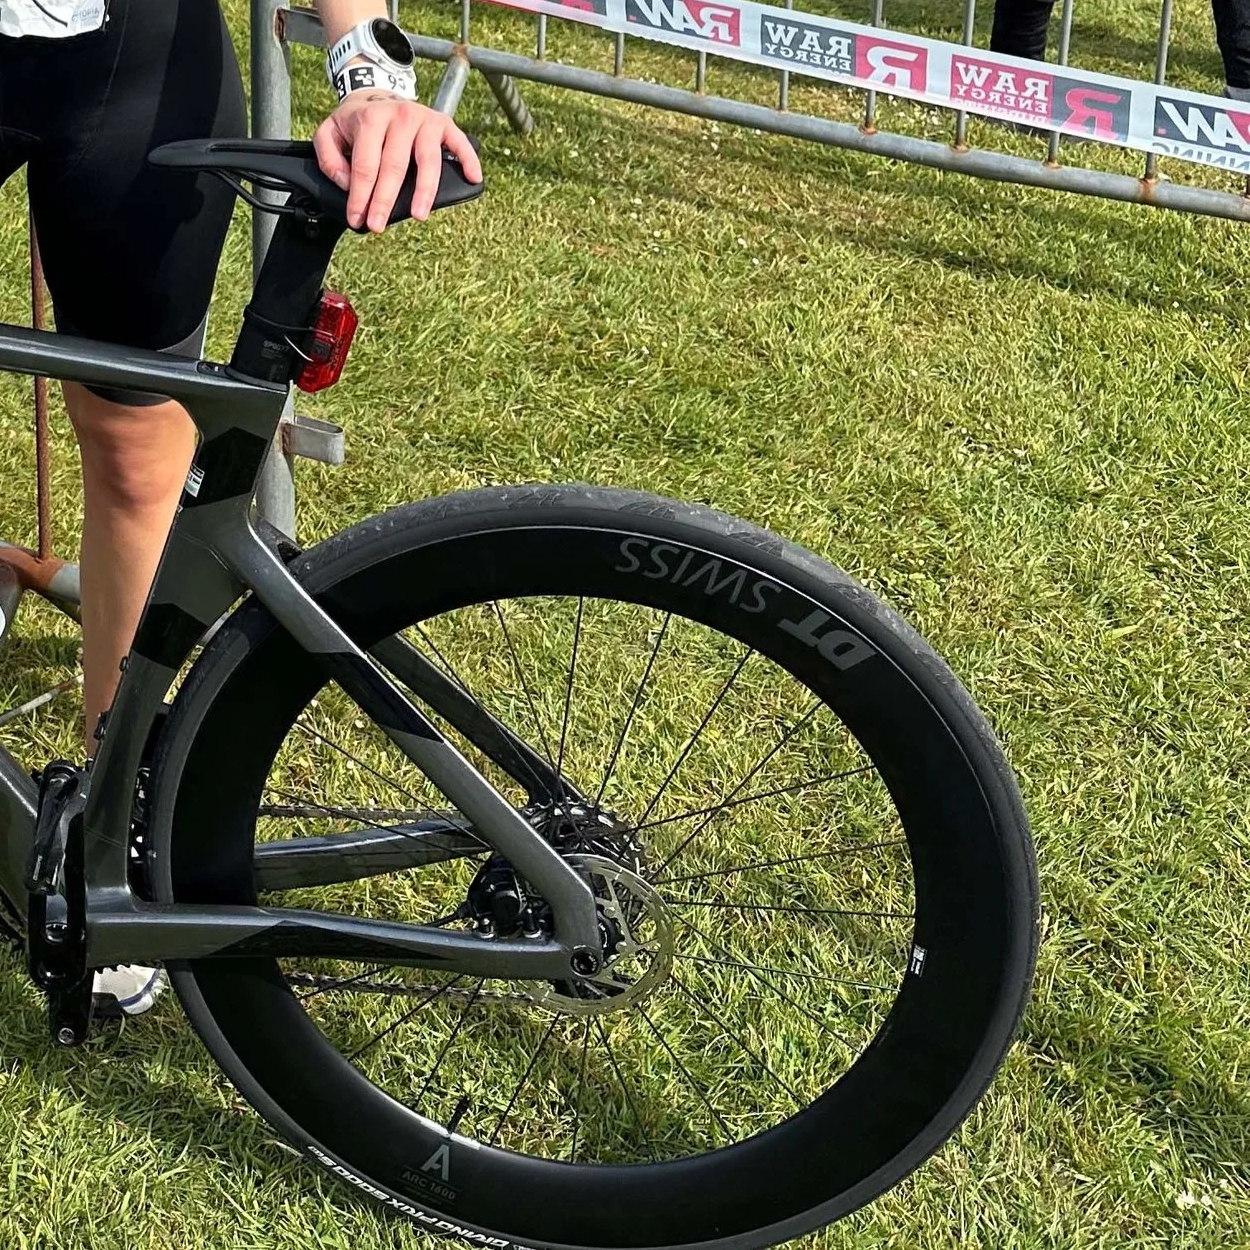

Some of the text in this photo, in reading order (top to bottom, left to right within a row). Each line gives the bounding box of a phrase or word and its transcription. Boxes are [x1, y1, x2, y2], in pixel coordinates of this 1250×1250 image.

[615, 537, 878, 671] SWISS DT
[332, 1165, 390, 1202] 5000
[402, 1170, 428, 1188] ARC
[429, 1182, 457, 1200] 1600
[386, 1197, 436, 1226] PRIX
[434, 1220, 510, 1248] GRAND
